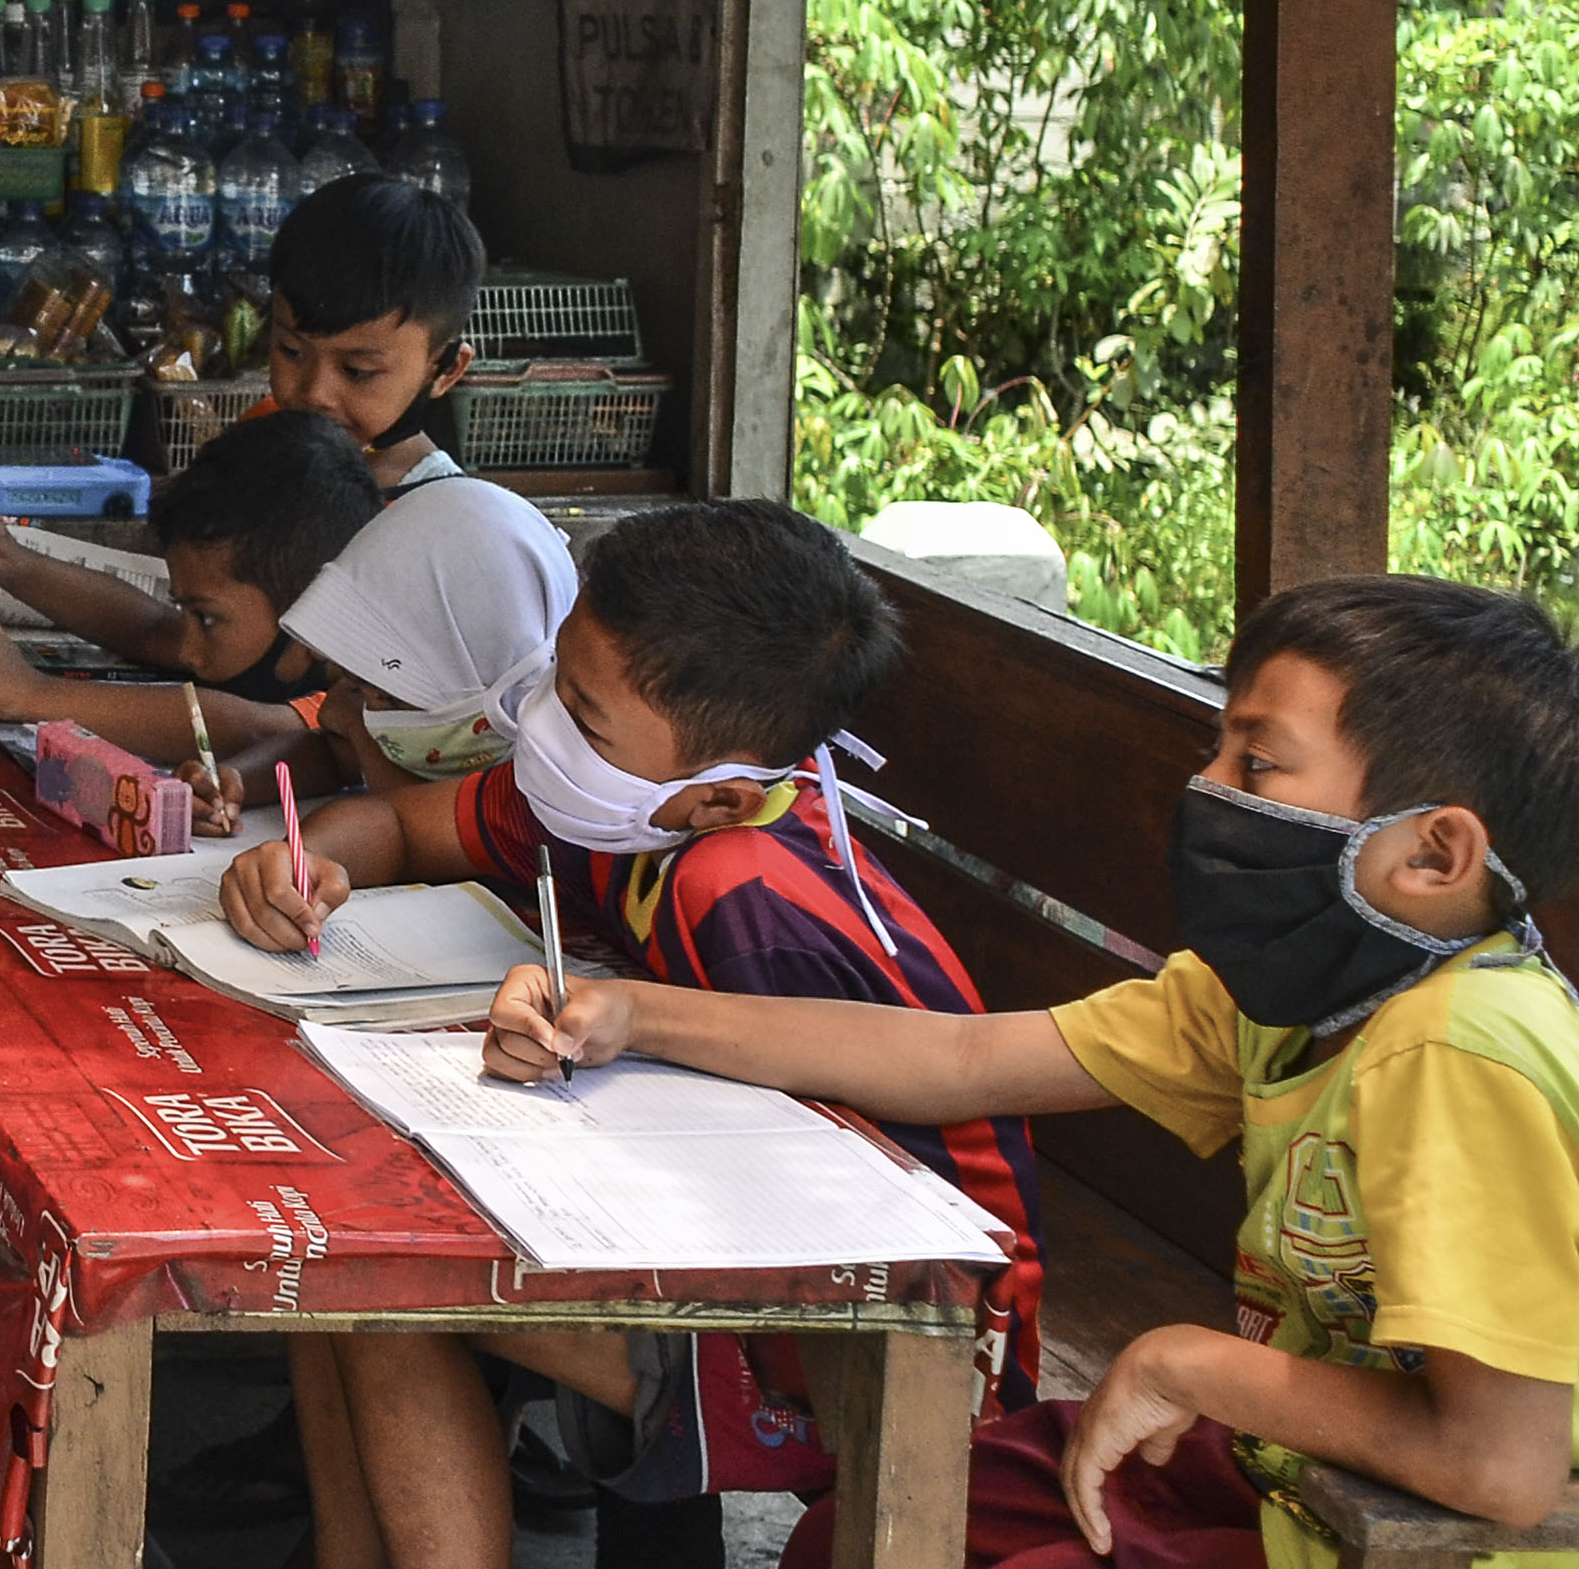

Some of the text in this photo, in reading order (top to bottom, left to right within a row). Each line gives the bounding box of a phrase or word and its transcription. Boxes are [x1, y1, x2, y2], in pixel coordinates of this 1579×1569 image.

[158, 204, 212, 227] AQUA
[16, 924, 100, 973] TORA
[67, 928, 152, 972] BIK
[144, 1093, 242, 1156] TORA
[202, 1094, 303, 1153] BIKA
[246, 1200, 284, 1223] Hati
[269, 1185, 311, 1209] Kopi
[272, 1257, 305, 1312] Untu
